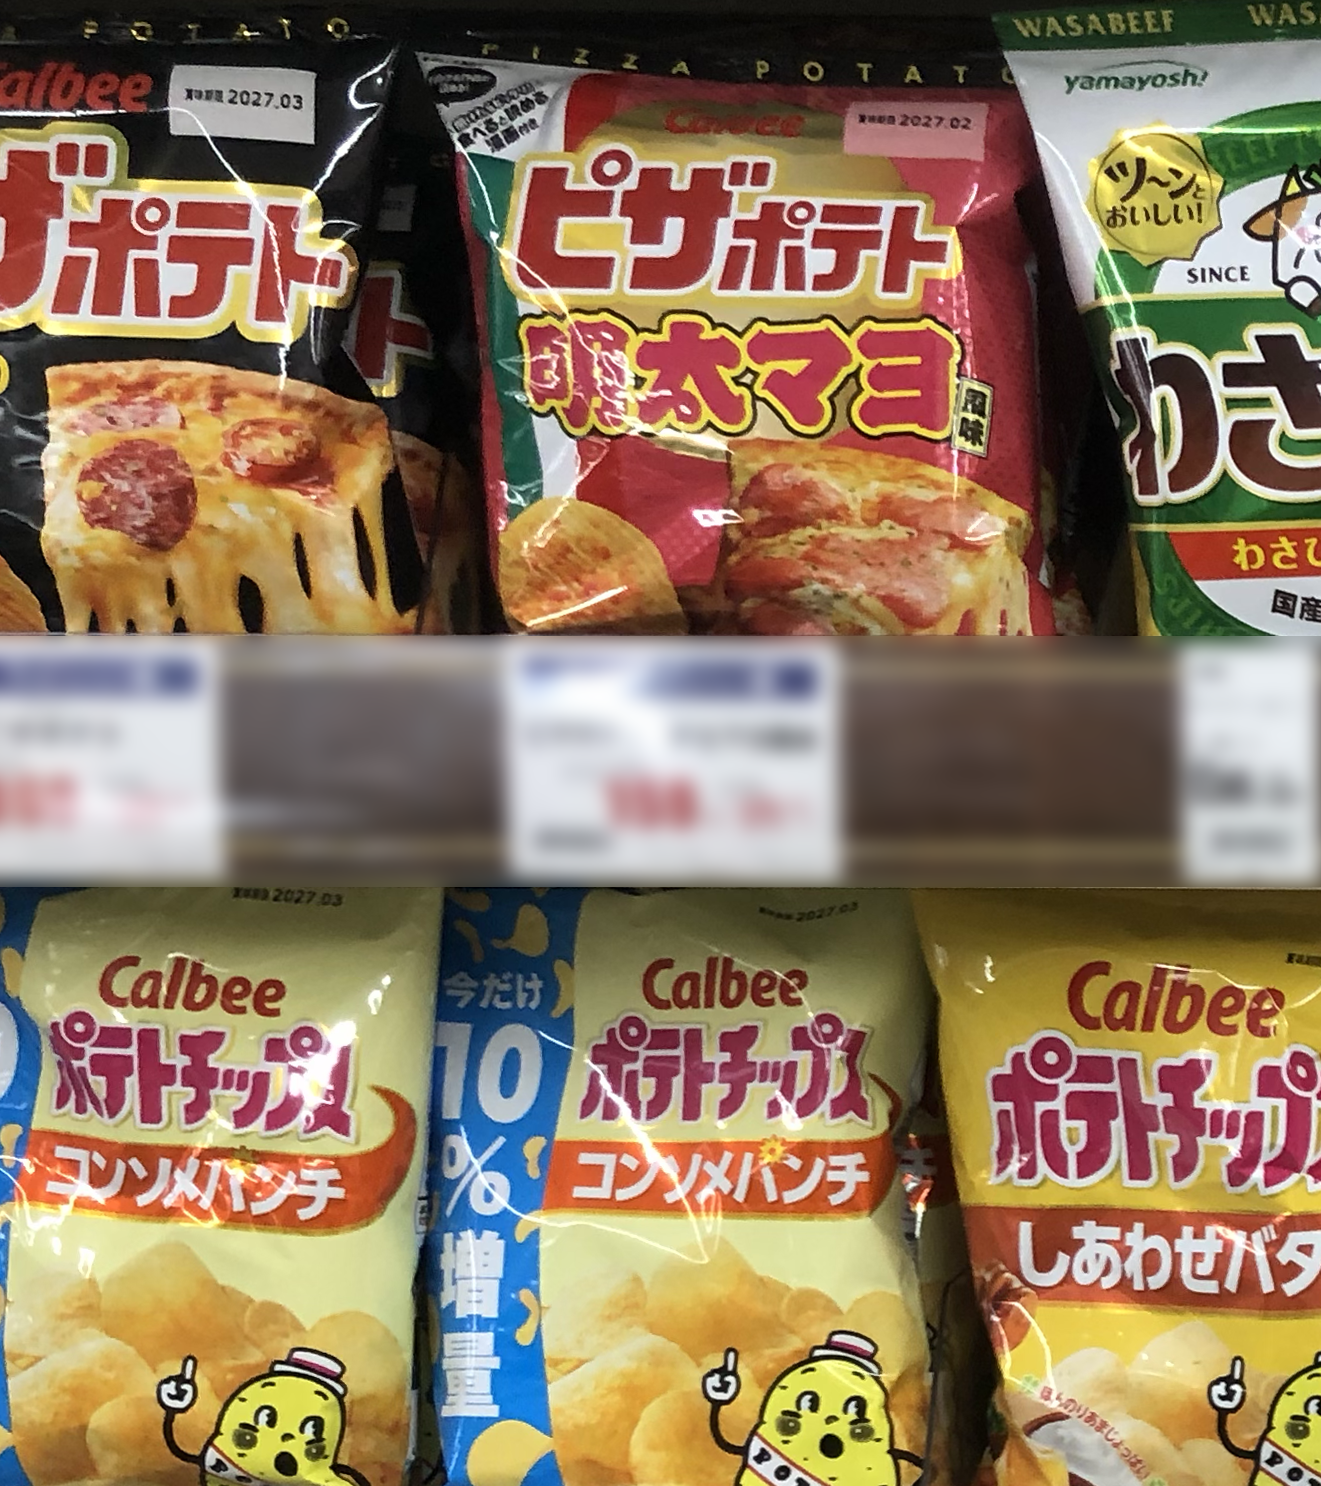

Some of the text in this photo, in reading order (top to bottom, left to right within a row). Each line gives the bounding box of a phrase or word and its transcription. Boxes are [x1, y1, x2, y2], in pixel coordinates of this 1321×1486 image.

[1013, 12, 1174, 38] WASABEEF
[0, 62, 153, 112] albee
[517, 150, 950, 295] ピザポテト
[1187, 266, 1250, 284] SINCE
[523, 315, 958, 437] 明太マヨ
[99, 955, 286, 1018] Calbee
[444, 972, 543, 1009] 今だけ
[642, 957, 809, 1009] Calbee
[1067, 961, 1285, 1037] Calbee
[579, 1011, 875, 1128] ポテトチップス
[46, 1145, 345, 1221] コンソメパンチ
[572, 1151, 870, 1205] コンソメパンチ
